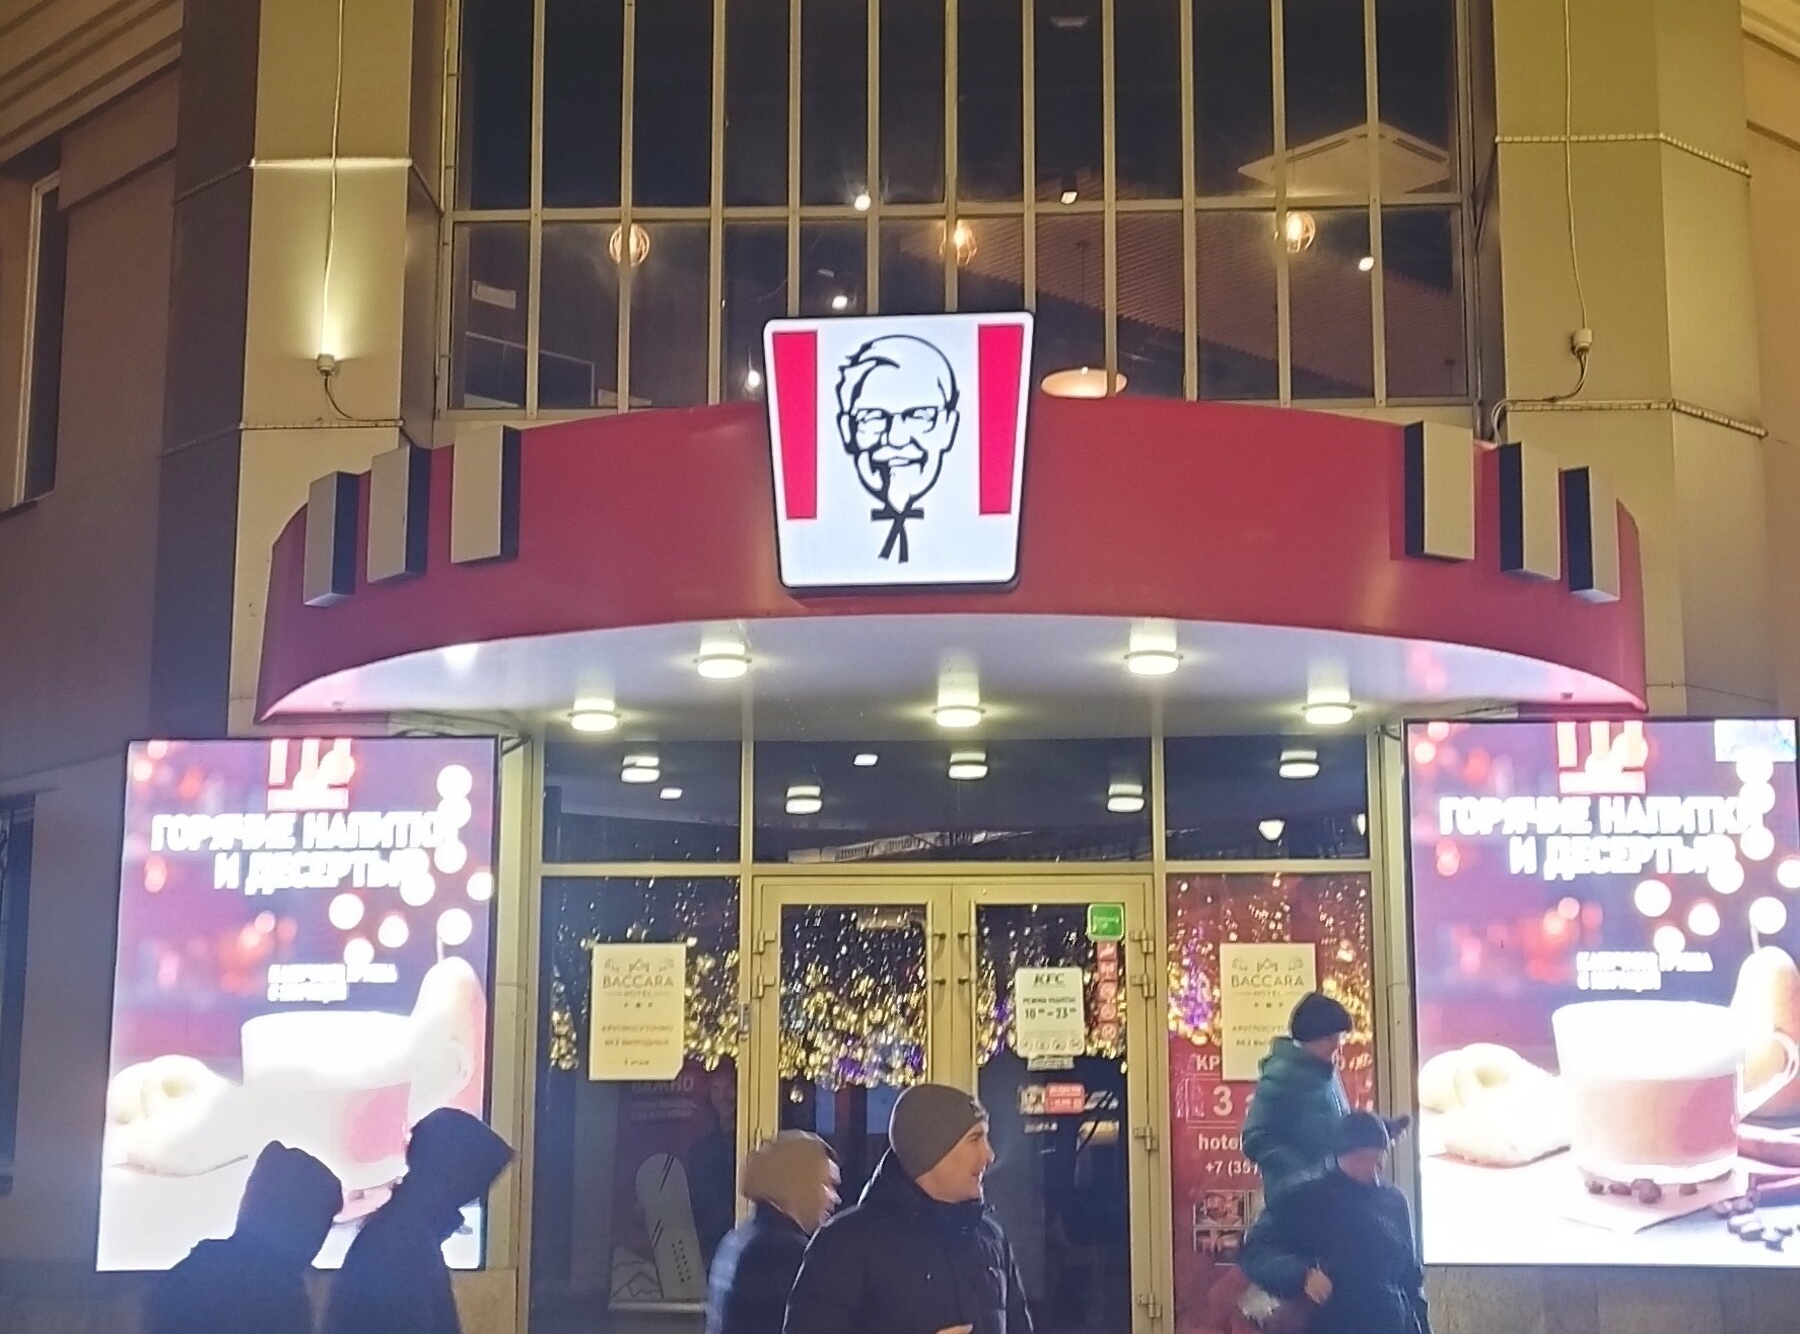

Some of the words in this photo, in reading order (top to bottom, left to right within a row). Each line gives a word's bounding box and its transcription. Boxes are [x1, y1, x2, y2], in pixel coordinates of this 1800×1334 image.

[1439, 796, 1593, 835] ГОРЯЧИЕ
[151, 813, 297, 851] ГОРЯЧИЕ
[213, 852, 240, 889] И
[244, 851, 402, 896] ДЕСЕРТЫ
[1509, 836, 1538, 874] И
[1543, 835, 1708, 881] ДЕСЕРТЫ
[603, 974, 674, 988] BACCARA
[1033, 973, 1065, 985] KFC
[1231, 974, 1304, 987] BACCARA
[1213, 1085, 1233, 1116] 3
[1205, 1160, 1223, 1174] +7
